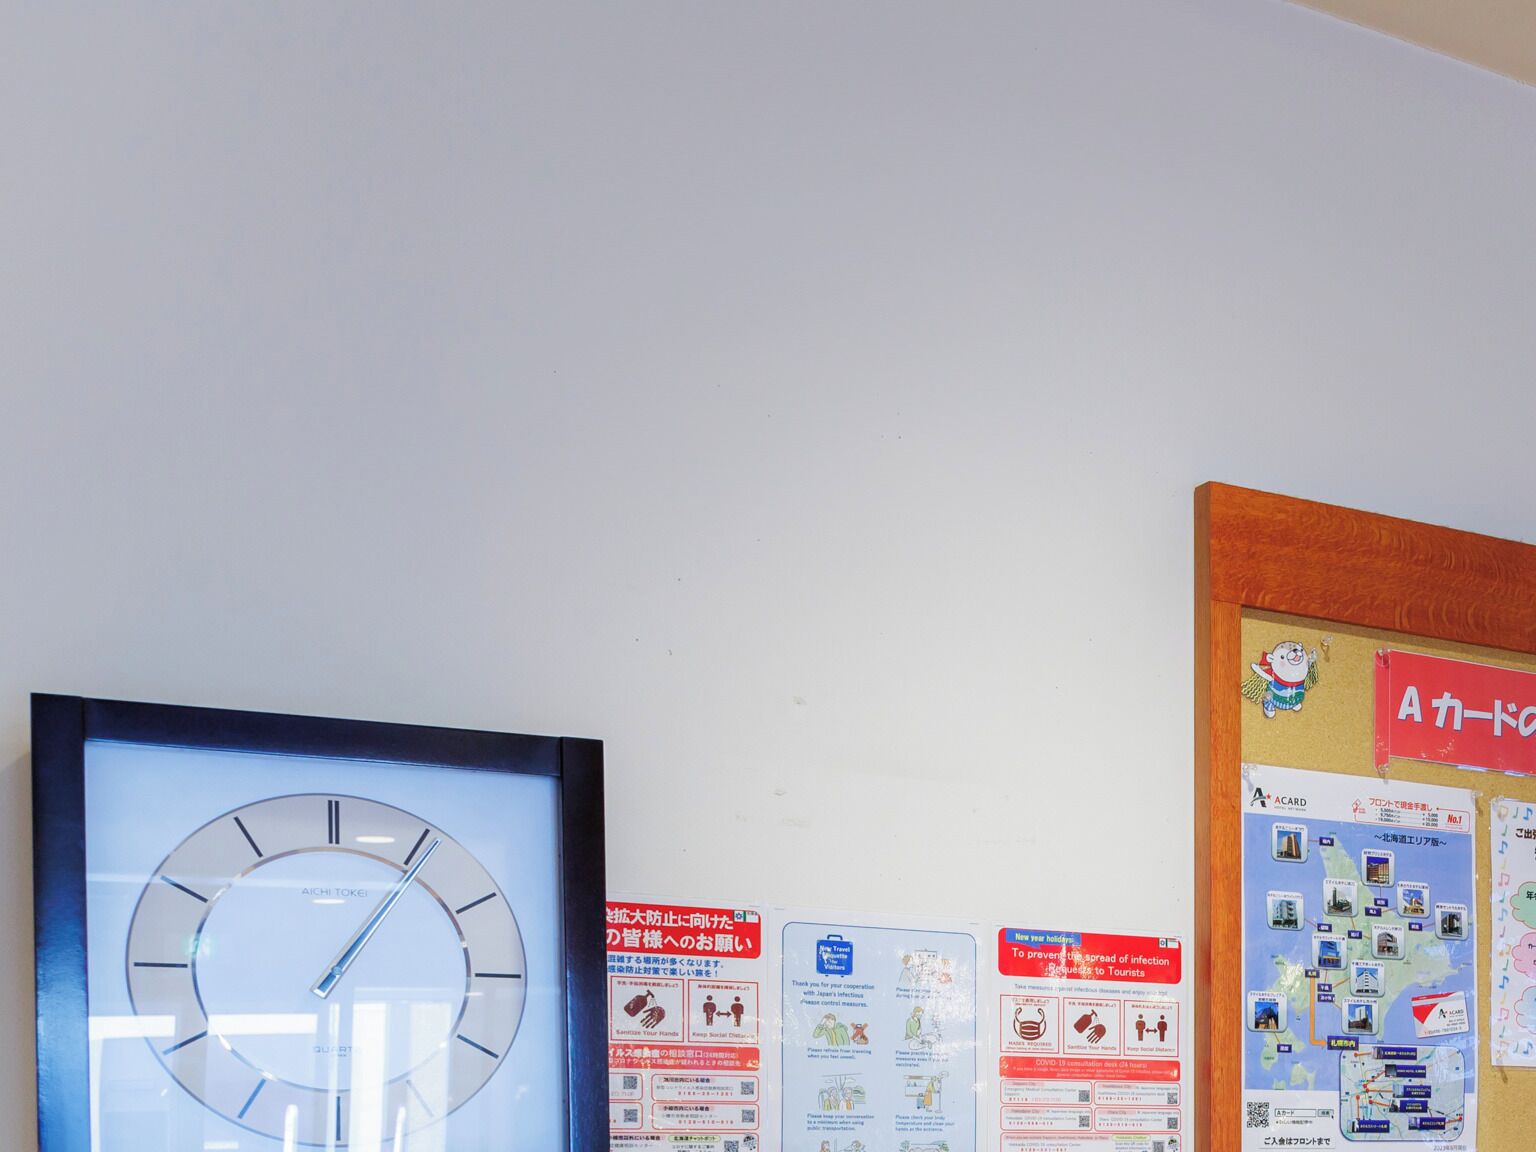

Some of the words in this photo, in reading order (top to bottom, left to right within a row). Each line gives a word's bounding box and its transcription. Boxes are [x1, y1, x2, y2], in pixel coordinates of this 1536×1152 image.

[1275, 796, 1306, 806] ACARD
[302, 887, 332, 897] AICHI
[335, 887, 368, 898] TOKEI
[1016, 933, 1028, 941] New
[1031, 934, 1044, 943] year
[1012, 948, 1024, 957] To
[1086, 954, 1116, 964] spread
[1119, 954, 1128, 963] of
[1131, 954, 1169, 966] infection
[1095, 967, 1104, 975] to
[1108, 967, 1144, 977] Tourists
[313, 1045, 363, 1054] QUART
[1264, 1136, 1330, 1145] ご入会はフロントまで
